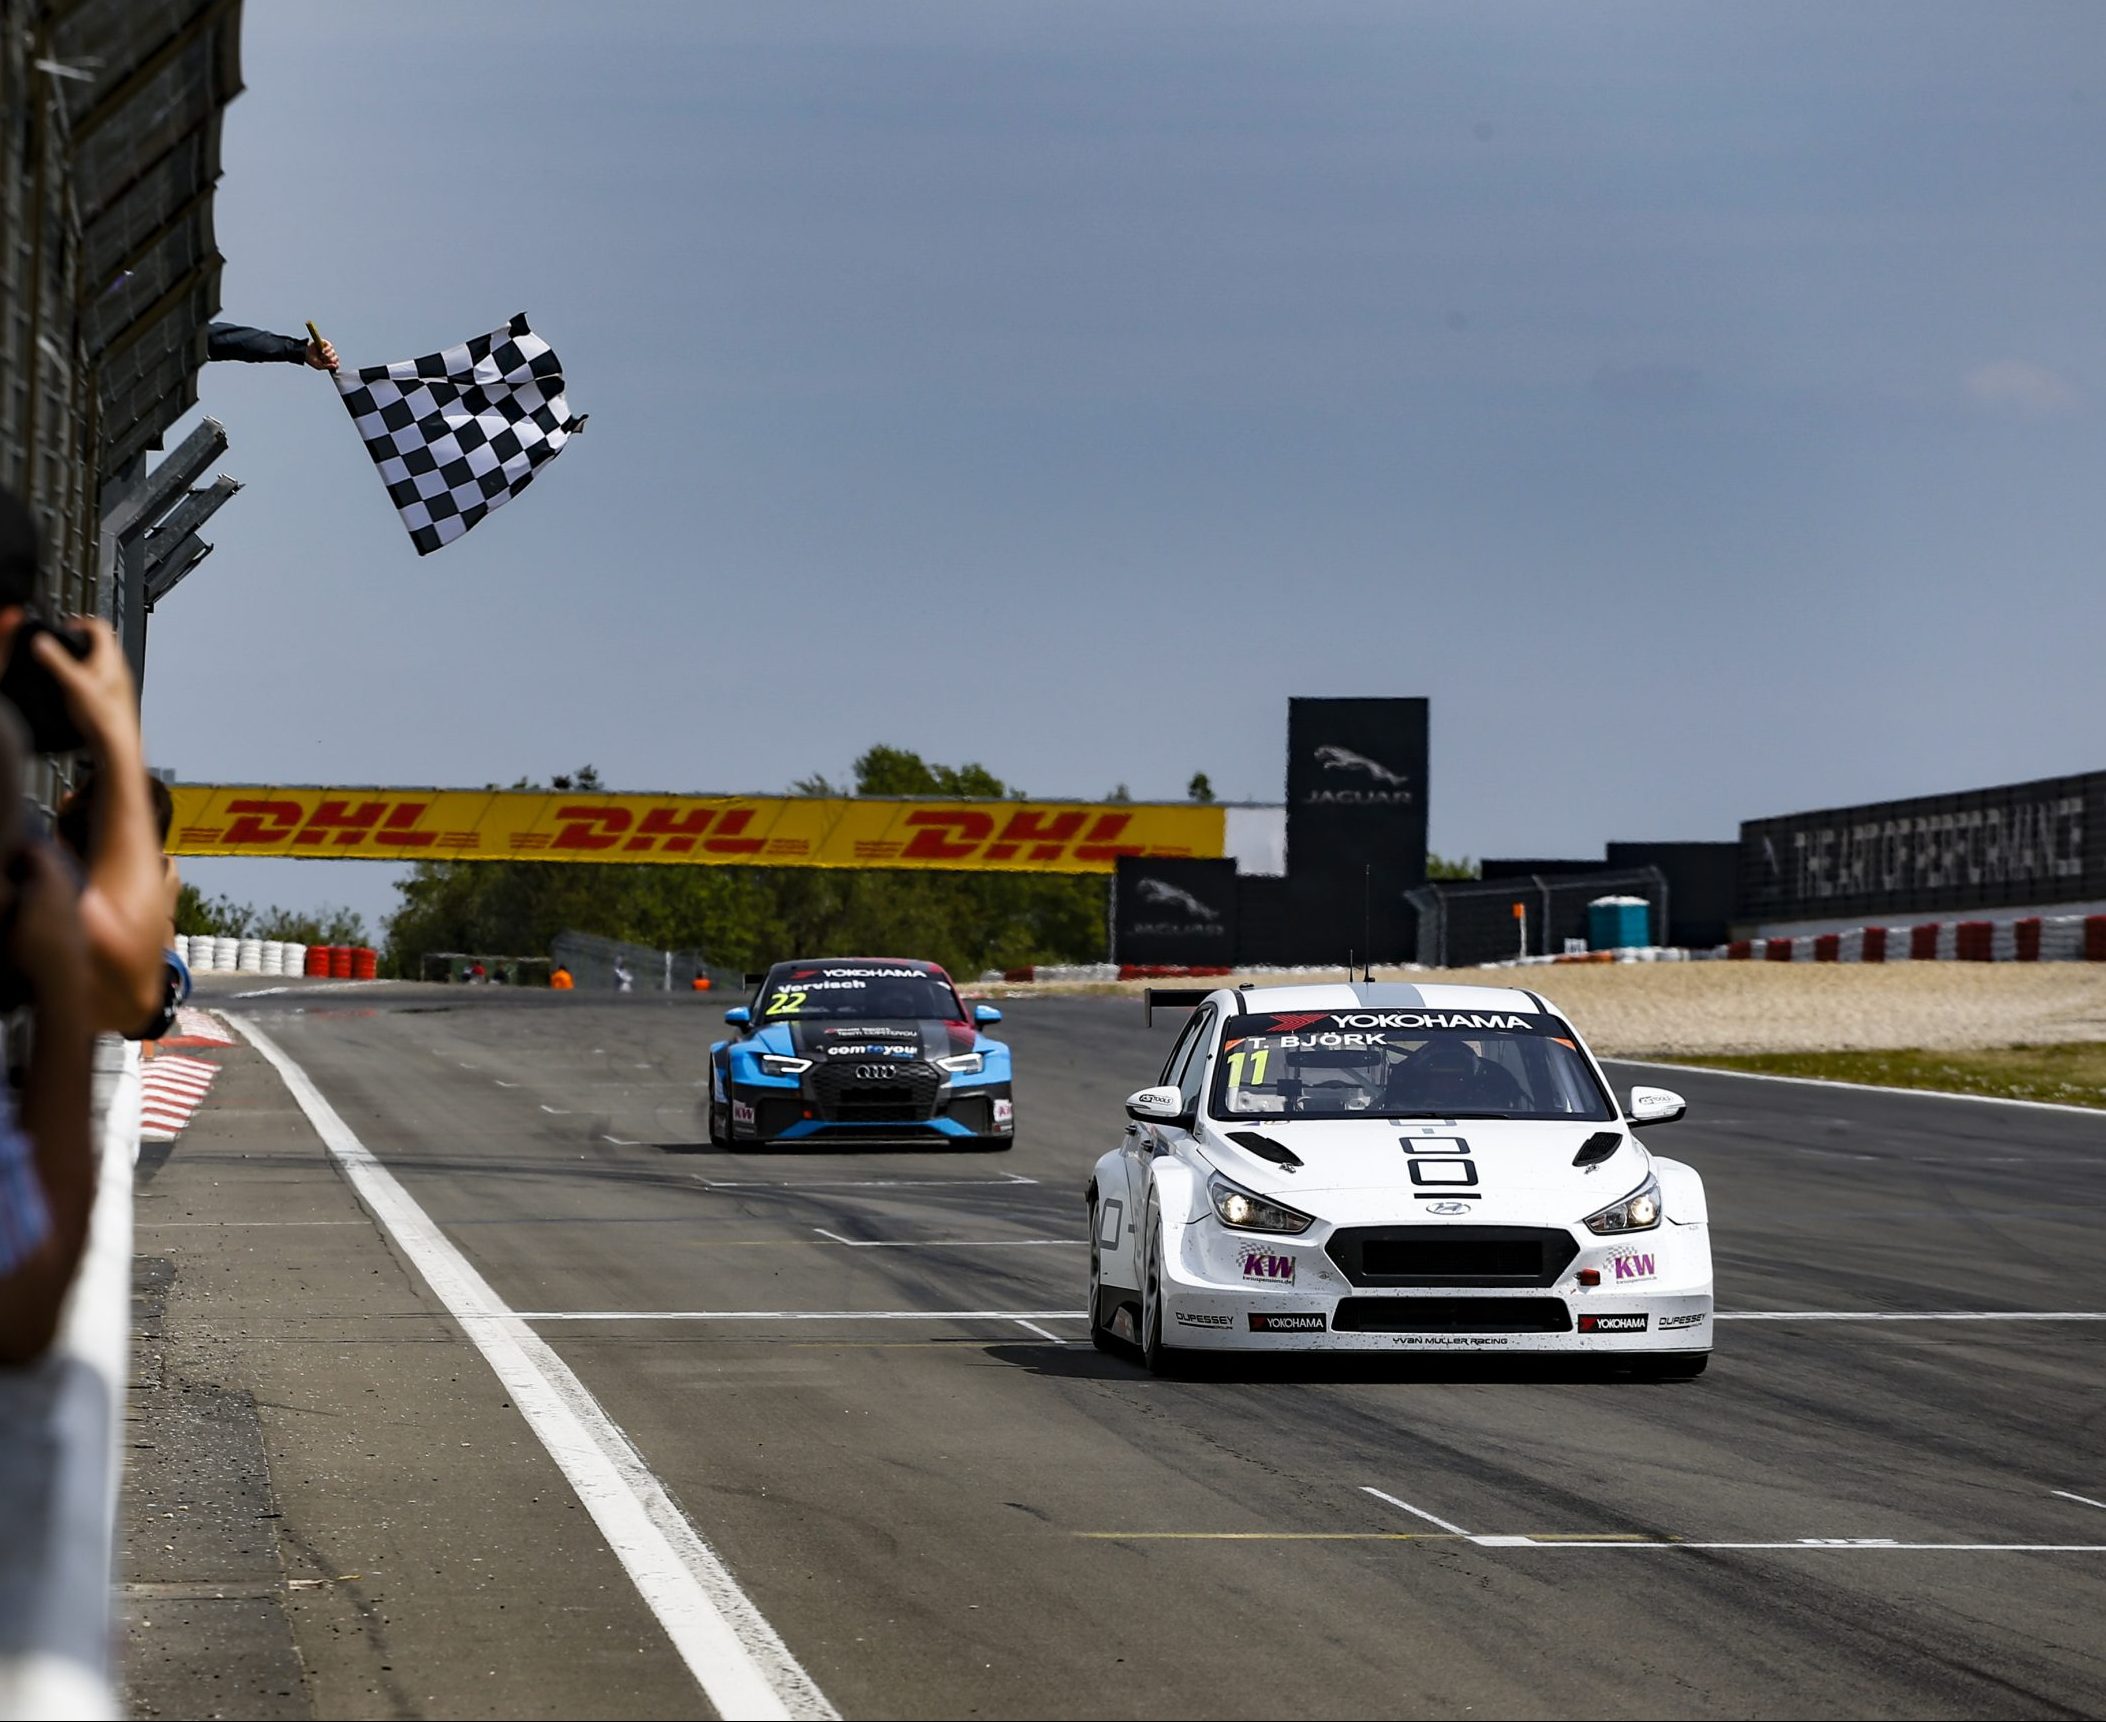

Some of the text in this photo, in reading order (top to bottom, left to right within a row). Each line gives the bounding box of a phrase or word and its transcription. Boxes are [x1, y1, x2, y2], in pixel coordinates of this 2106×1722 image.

[219, 799, 439, 847] DHL
[550, 805, 768, 853] DHL
[901, 809, 1146, 861] DHL
[823, 968, 927, 978] YOKOHAMA
[765, 992, 807, 1016] 22
[1330, 1013, 1534, 1030] YOKOHAMA
[1247, 1032, 1388, 1049] T. BJÖRK
[1226, 1050, 1269, 1088] 11
[1243, 1254, 1296, 1279] KW
[1615, 1253, 1655, 1279] KW
[1175, 1312, 1234, 1326] DUPESSEY
[1267, 1317, 1324, 1329] YOKOHAMA
[1597, 1318, 1646, 1329] YOKOHAMA
[1659, 1312, 1707, 1325] DUPESSEY
